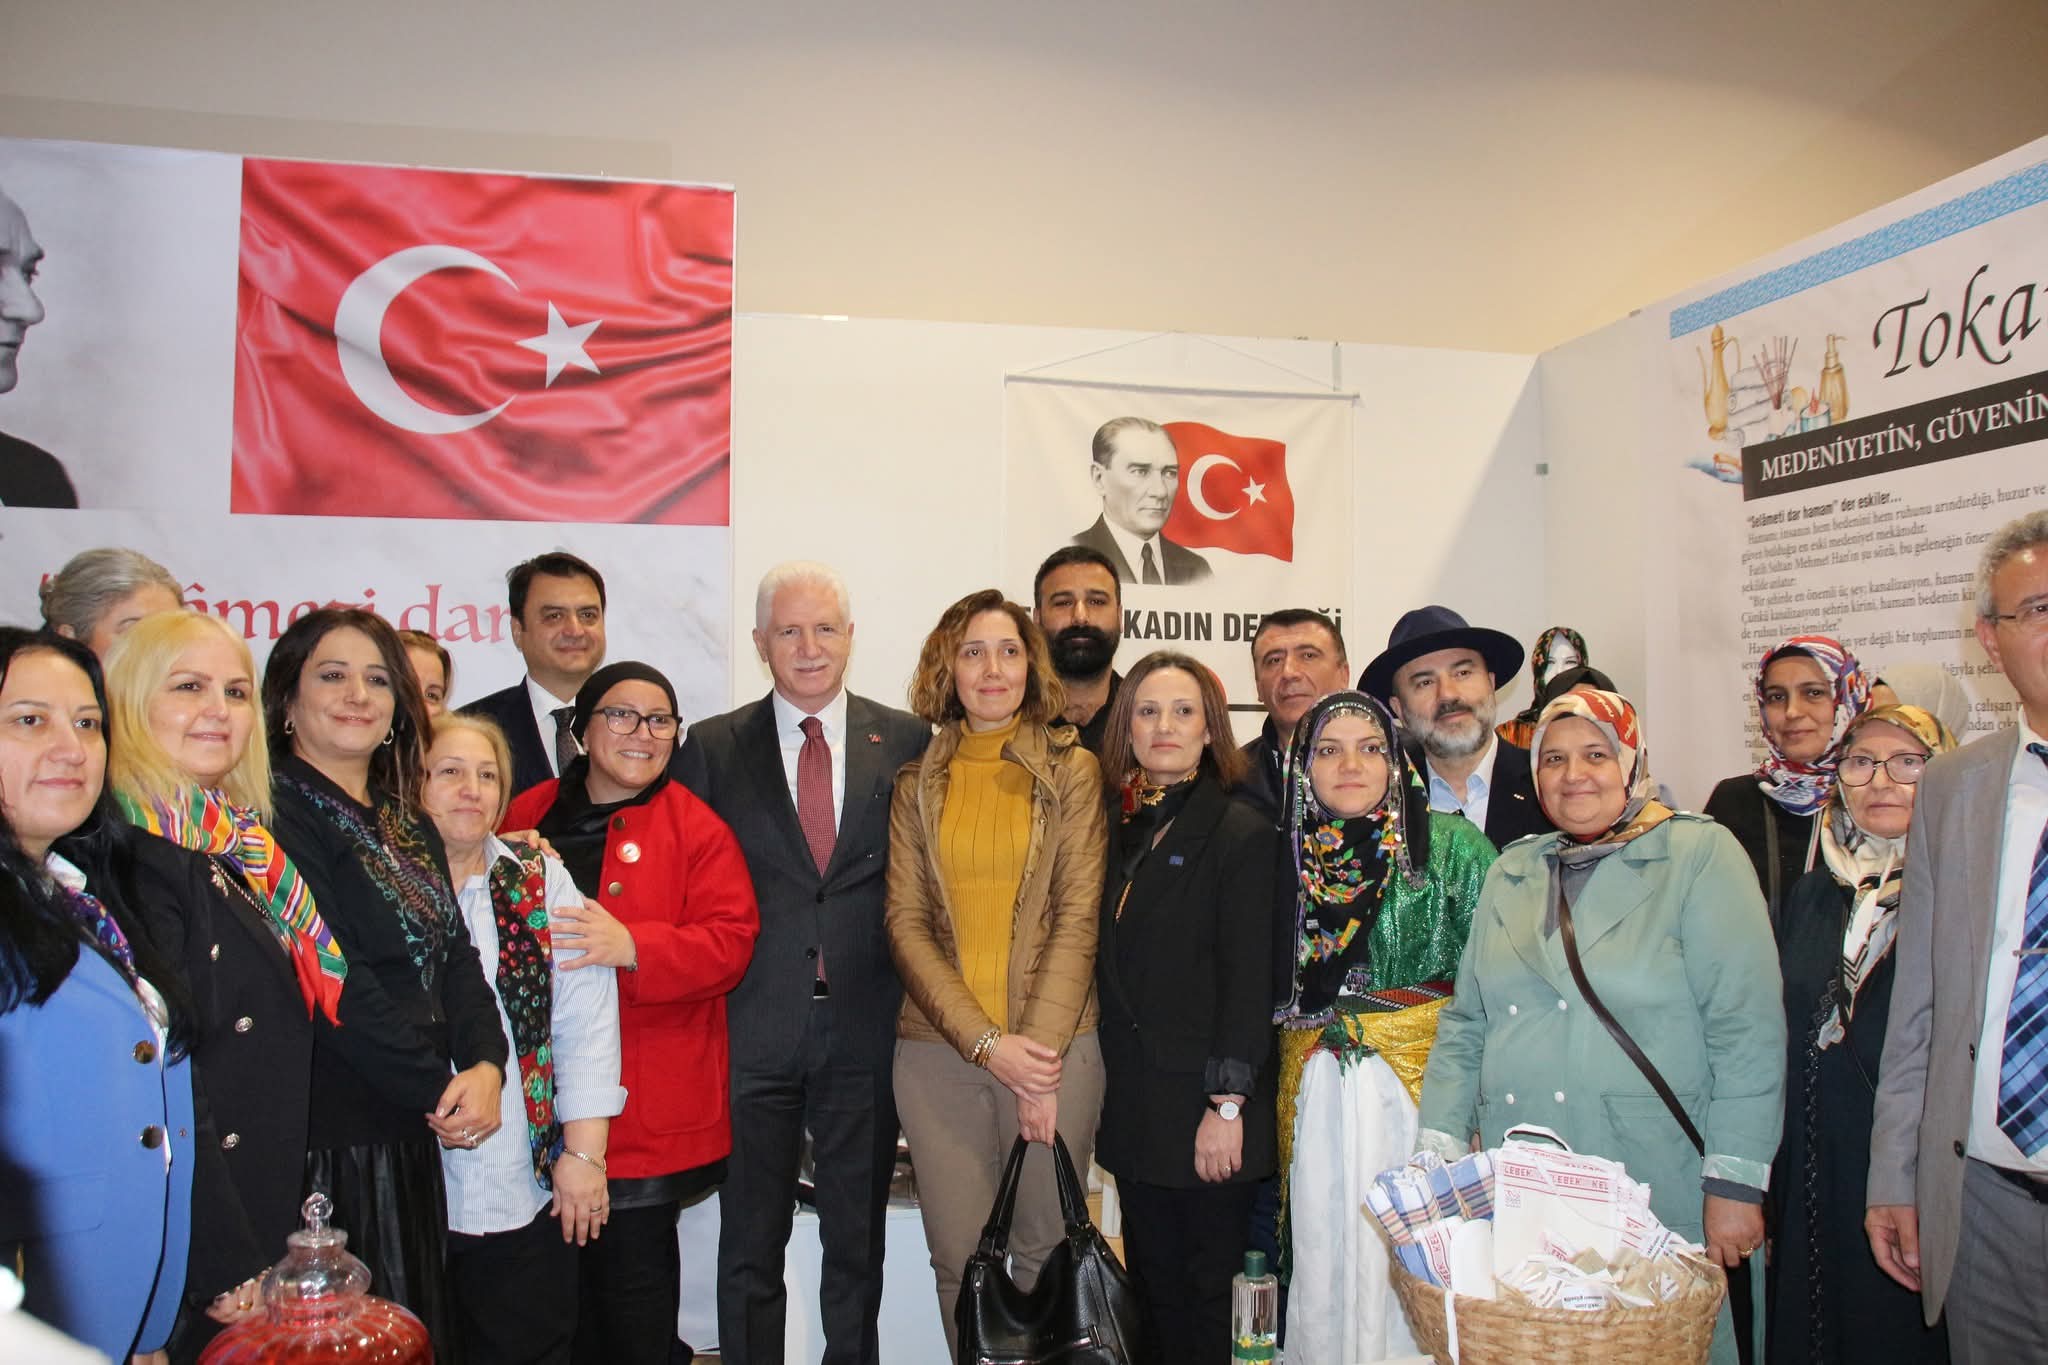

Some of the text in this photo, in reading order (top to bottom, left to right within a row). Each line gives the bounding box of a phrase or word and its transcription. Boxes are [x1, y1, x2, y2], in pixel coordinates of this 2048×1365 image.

[1873, 264, 2048, 378] Toka
[1761, 389, 2048, 481] MEDENİYETİN, GÜVENİN
[1787, 508, 1801, 522] dar
[1841, 498, 1856, 512] der
[1858, 491, 1901, 509] eskiler...
[1873, 511, 1893, 524] hem
[1935, 492, 1995, 511] arındırdığı,
[1998, 487, 2030, 502] huzur
[2033, 485, 2046, 496] ve
[1900, 542, 1912, 555] bu
[1915, 535, 1963, 556] geleneğin
[1936, 572, 1974, 586] hamam
[400, 583, 511, 644] dar
[1918, 591, 1960, 606] bedenin
[1123, 610, 1212, 641] KADIN
[1854, 637, 1867, 650] yer
[1896, 630, 1910, 643] bir
[1913, 627, 1962, 645] toplumun
